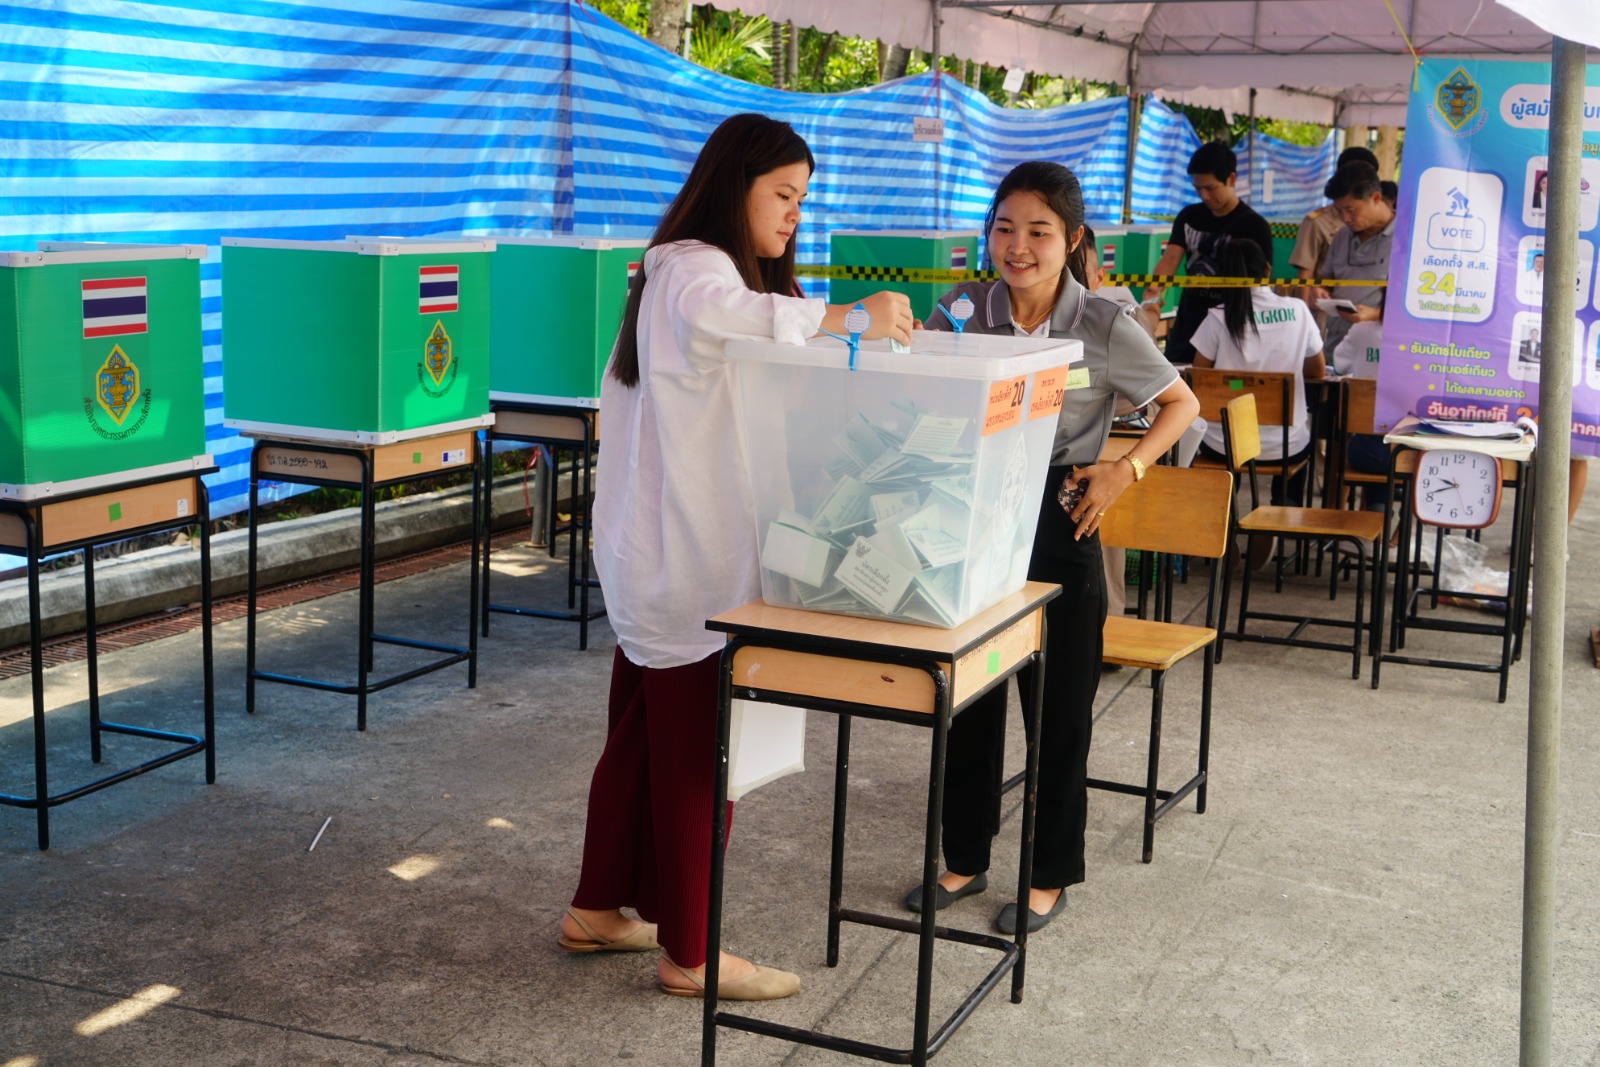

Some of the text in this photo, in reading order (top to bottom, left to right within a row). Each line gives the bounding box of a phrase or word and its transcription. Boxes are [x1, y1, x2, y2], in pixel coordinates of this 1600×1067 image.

[1441, 227, 1473, 239] VOTE
[1423, 254, 1489, 270] เลือกตั้ง ส.ส.
[1417, 271, 1486, 298] 24 มีนาคม
[1410, 341, 1491, 360] รับบัตรใบเดียว
[1428, 363, 1496, 377] กาเบอร์เดียว
[1010, 380, 1025, 408] 20
[1444, 379, 1526, 399] ได้ผลสามอย่าง
[1053, 388, 1064, 407] 20
[1441, 456, 1449, 466] 11
[1454, 454, 1466, 464] 12
[1429, 466, 1439, 475] 10
[1479, 469, 1488, 479] 2
[1422, 478, 1430, 489] 9
[1483, 484, 1491, 494] 3
[1425, 492, 1434, 502] 8
[1436, 503, 1444, 513] 7
[1450, 508, 1458, 518] 6
[1465, 505, 1474, 516] 5
